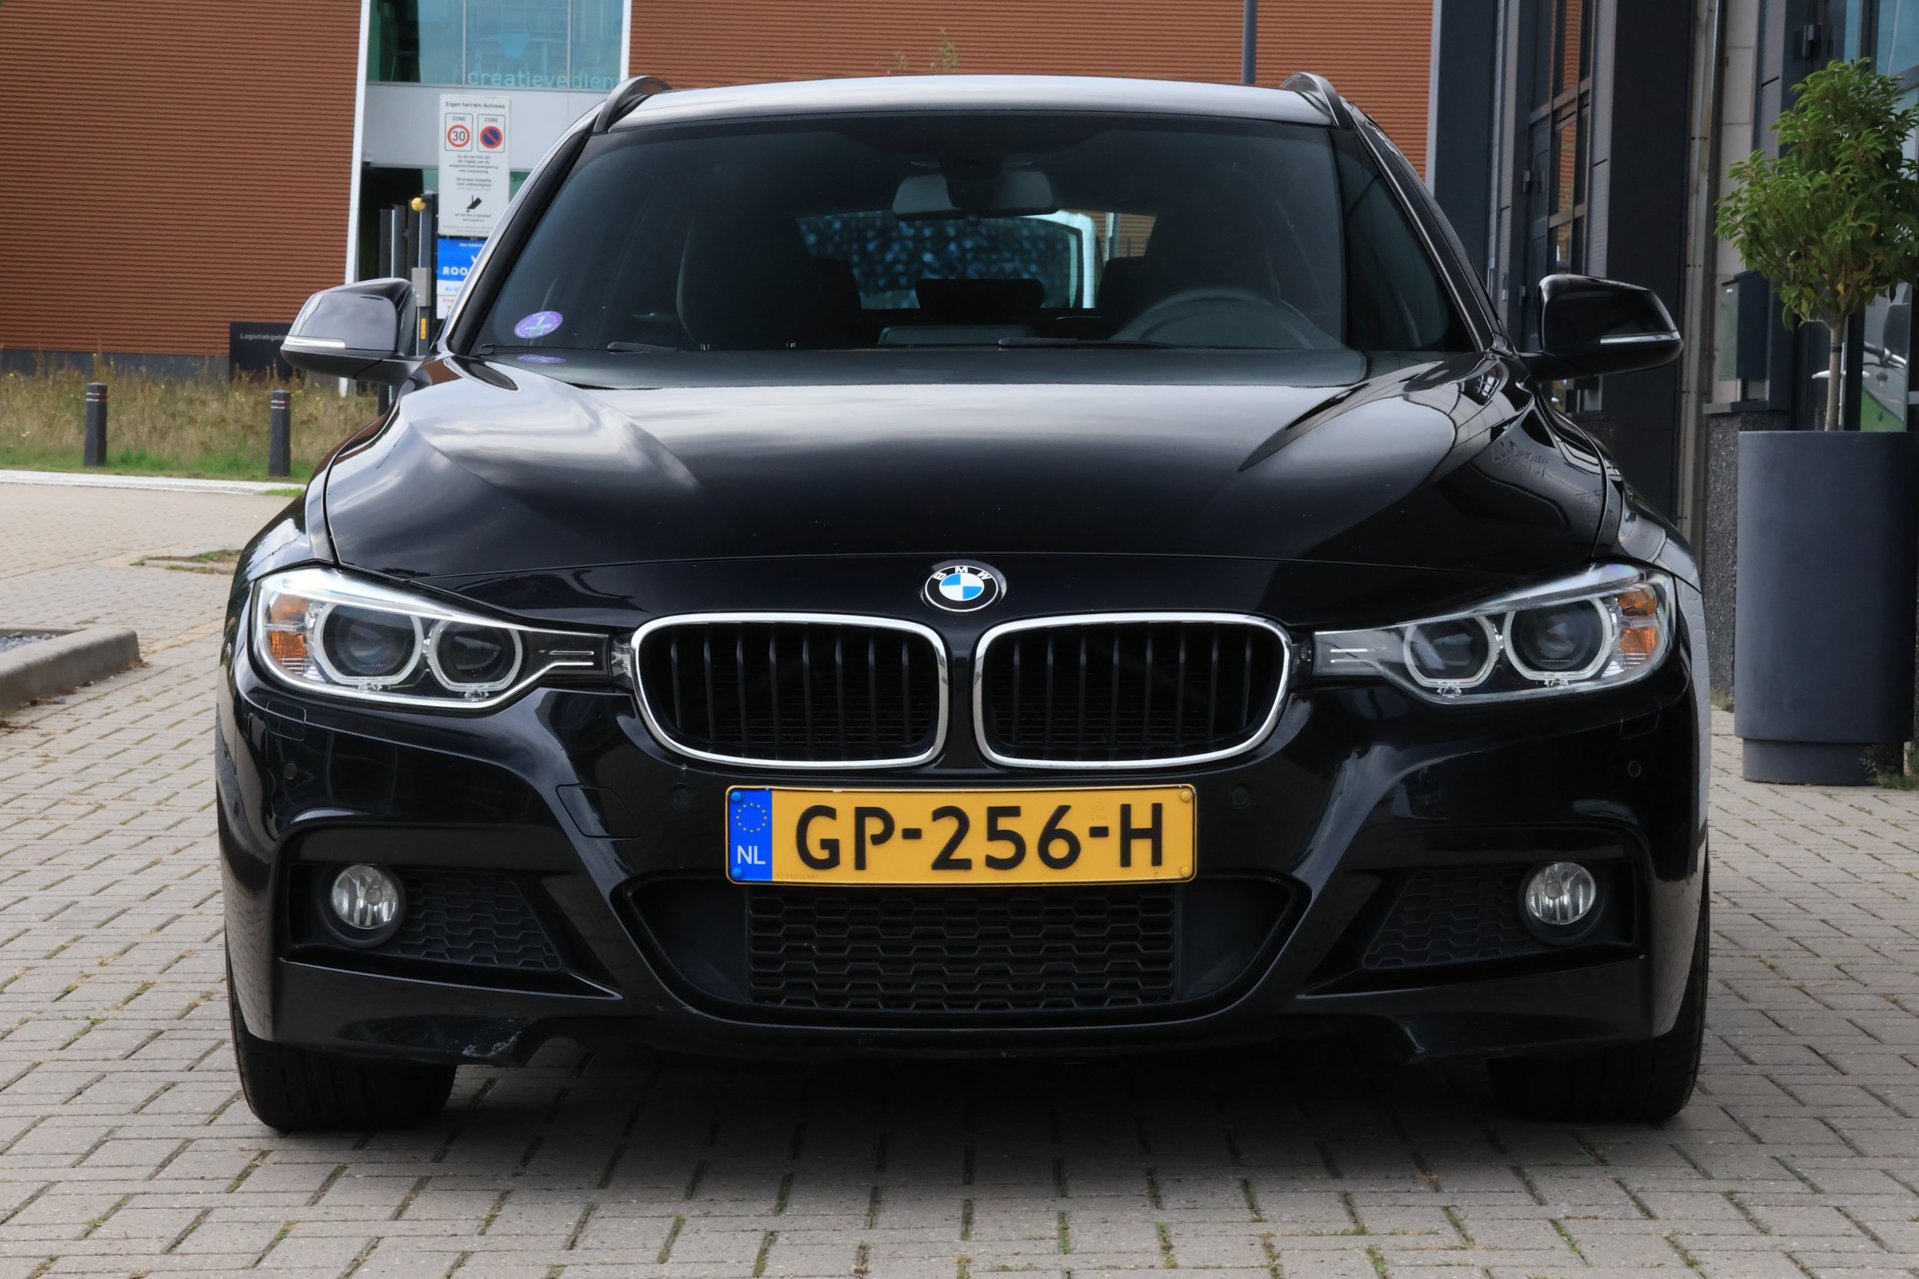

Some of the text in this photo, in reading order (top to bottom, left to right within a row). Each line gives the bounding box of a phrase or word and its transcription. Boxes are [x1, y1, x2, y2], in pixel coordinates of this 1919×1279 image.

[452, 130, 466, 142] 30
[442, 266, 471, 276] ROO
[933, 565, 993, 581] BMW
[795, 802, 1164, 871] GP-256-H
[736, 844, 767, 866] NL
